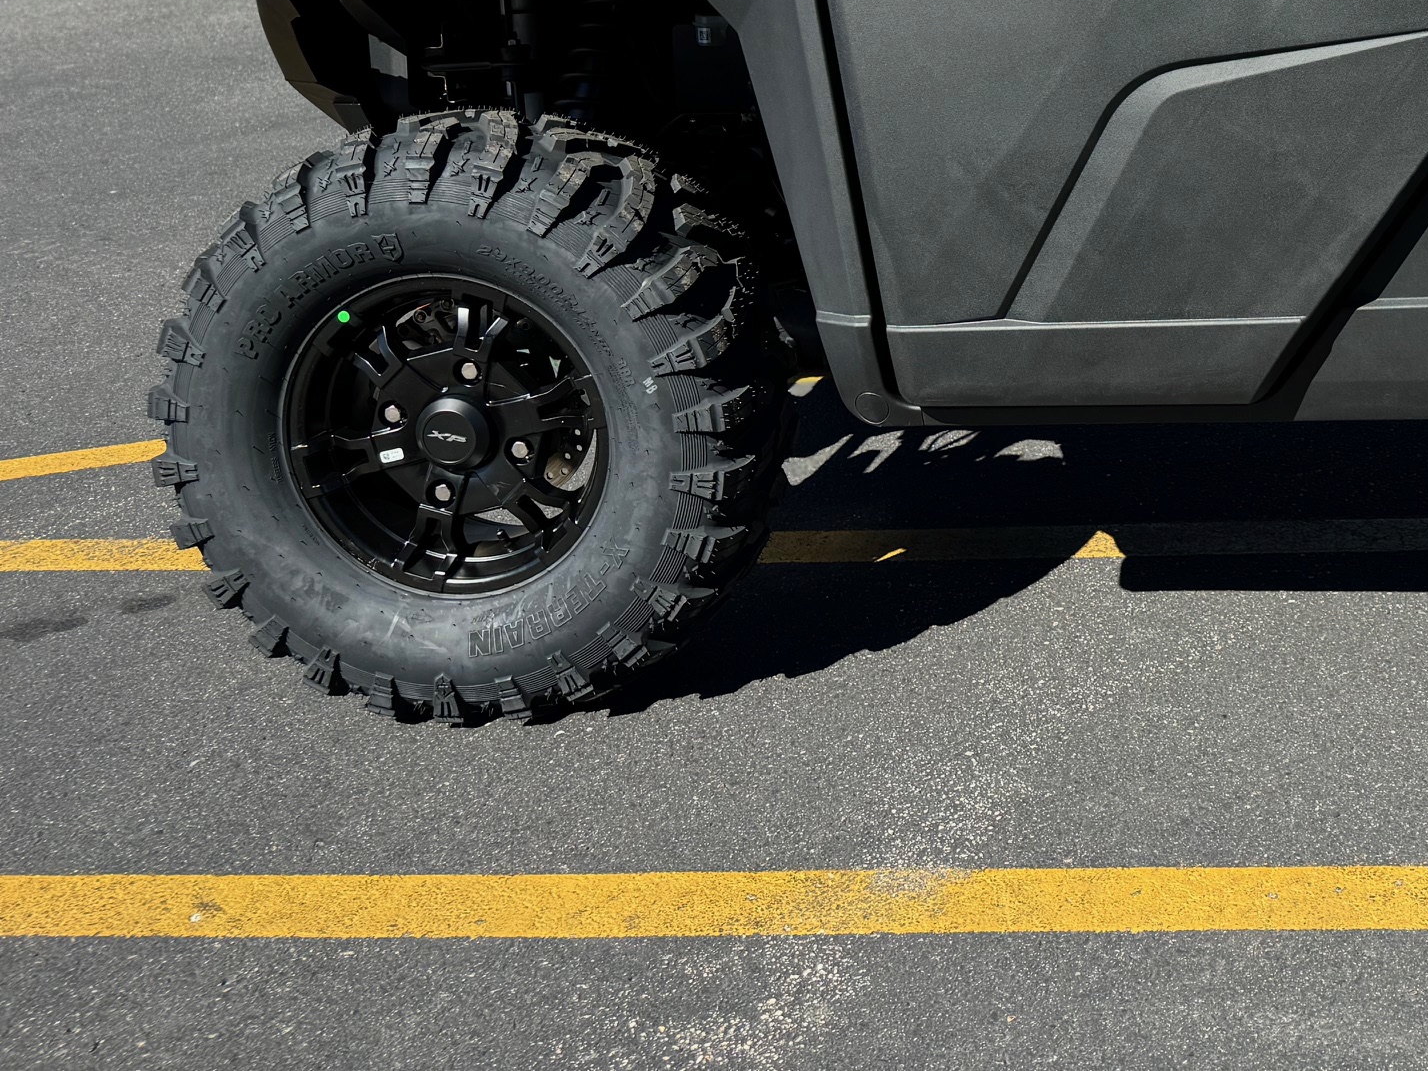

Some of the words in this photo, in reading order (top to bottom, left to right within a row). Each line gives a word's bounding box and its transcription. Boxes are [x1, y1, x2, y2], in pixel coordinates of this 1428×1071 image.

[235, 304, 283, 360] PRO
[273, 242, 376, 309] ARMOR
[642, 376, 659, 395] MB
[426, 430, 467, 443] XP
[468, 536, 630, 658] X-TERRAIN
